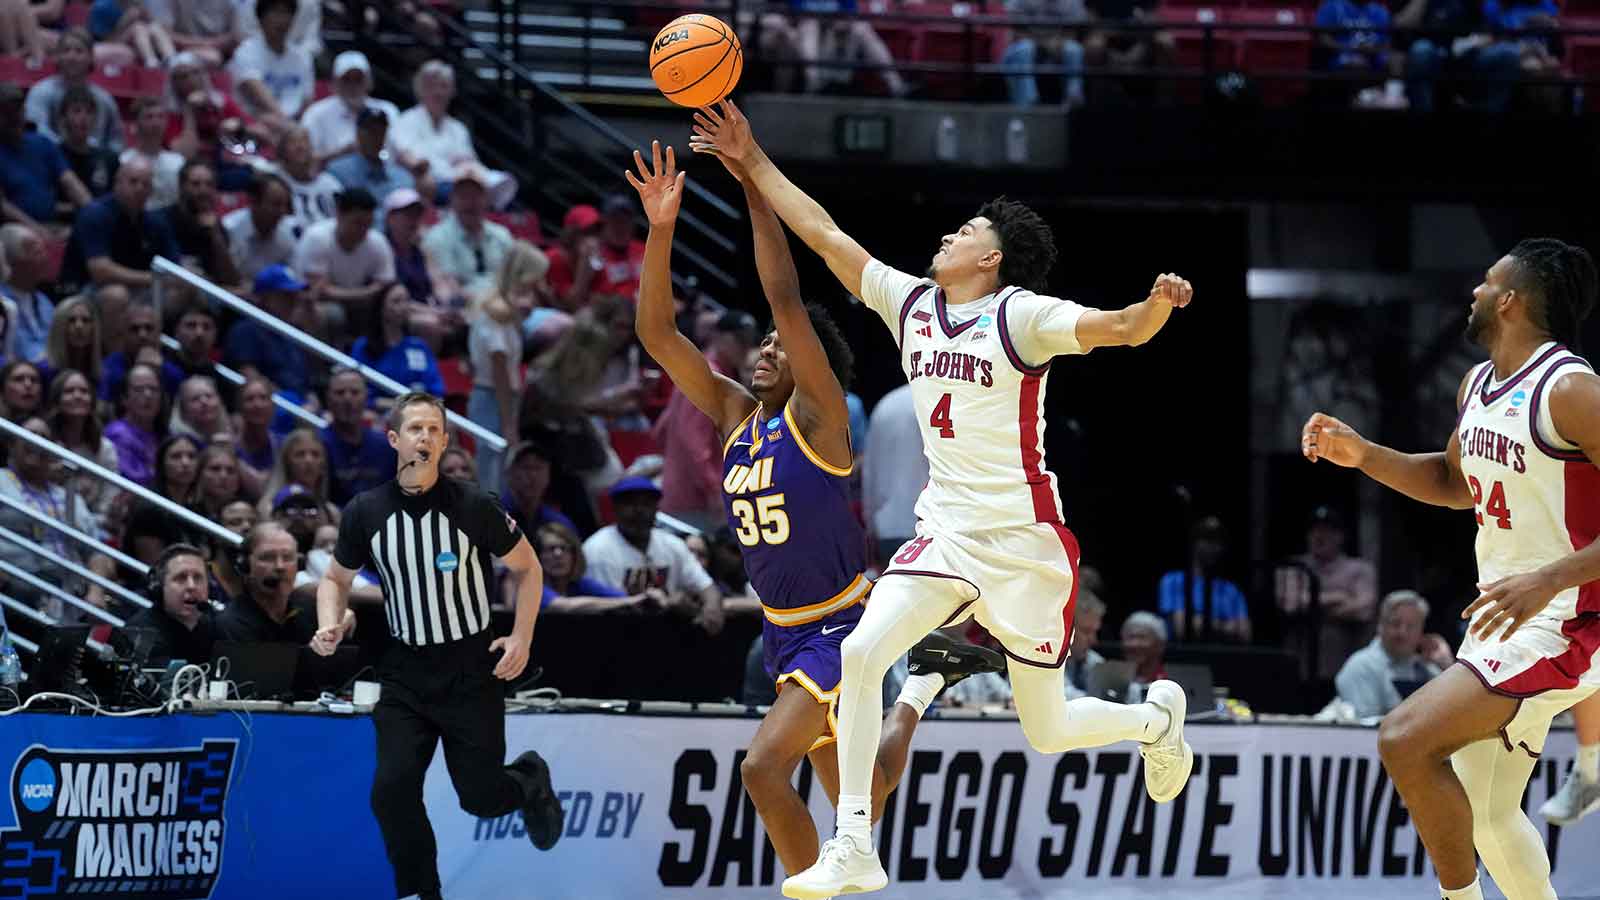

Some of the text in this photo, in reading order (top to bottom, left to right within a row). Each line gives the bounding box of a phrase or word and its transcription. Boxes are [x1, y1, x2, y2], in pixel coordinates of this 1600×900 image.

[653, 29, 688, 54] NCAA
[925, 350, 993, 388] JOHN'S
[930, 393, 955, 438] 4
[1468, 426, 1526, 474] JOHN'S
[723, 456, 775, 494] UNI
[732, 493, 790, 546] 35
[56, 761, 181, 818] MARCH
[595, 791, 645, 839] BY
[833, 750, 1028, 883] IEGO
[1038, 752, 1238, 878] STATE
[1258, 755, 1577, 878] UNIVEY
[74, 820, 221, 878] MADNESS
